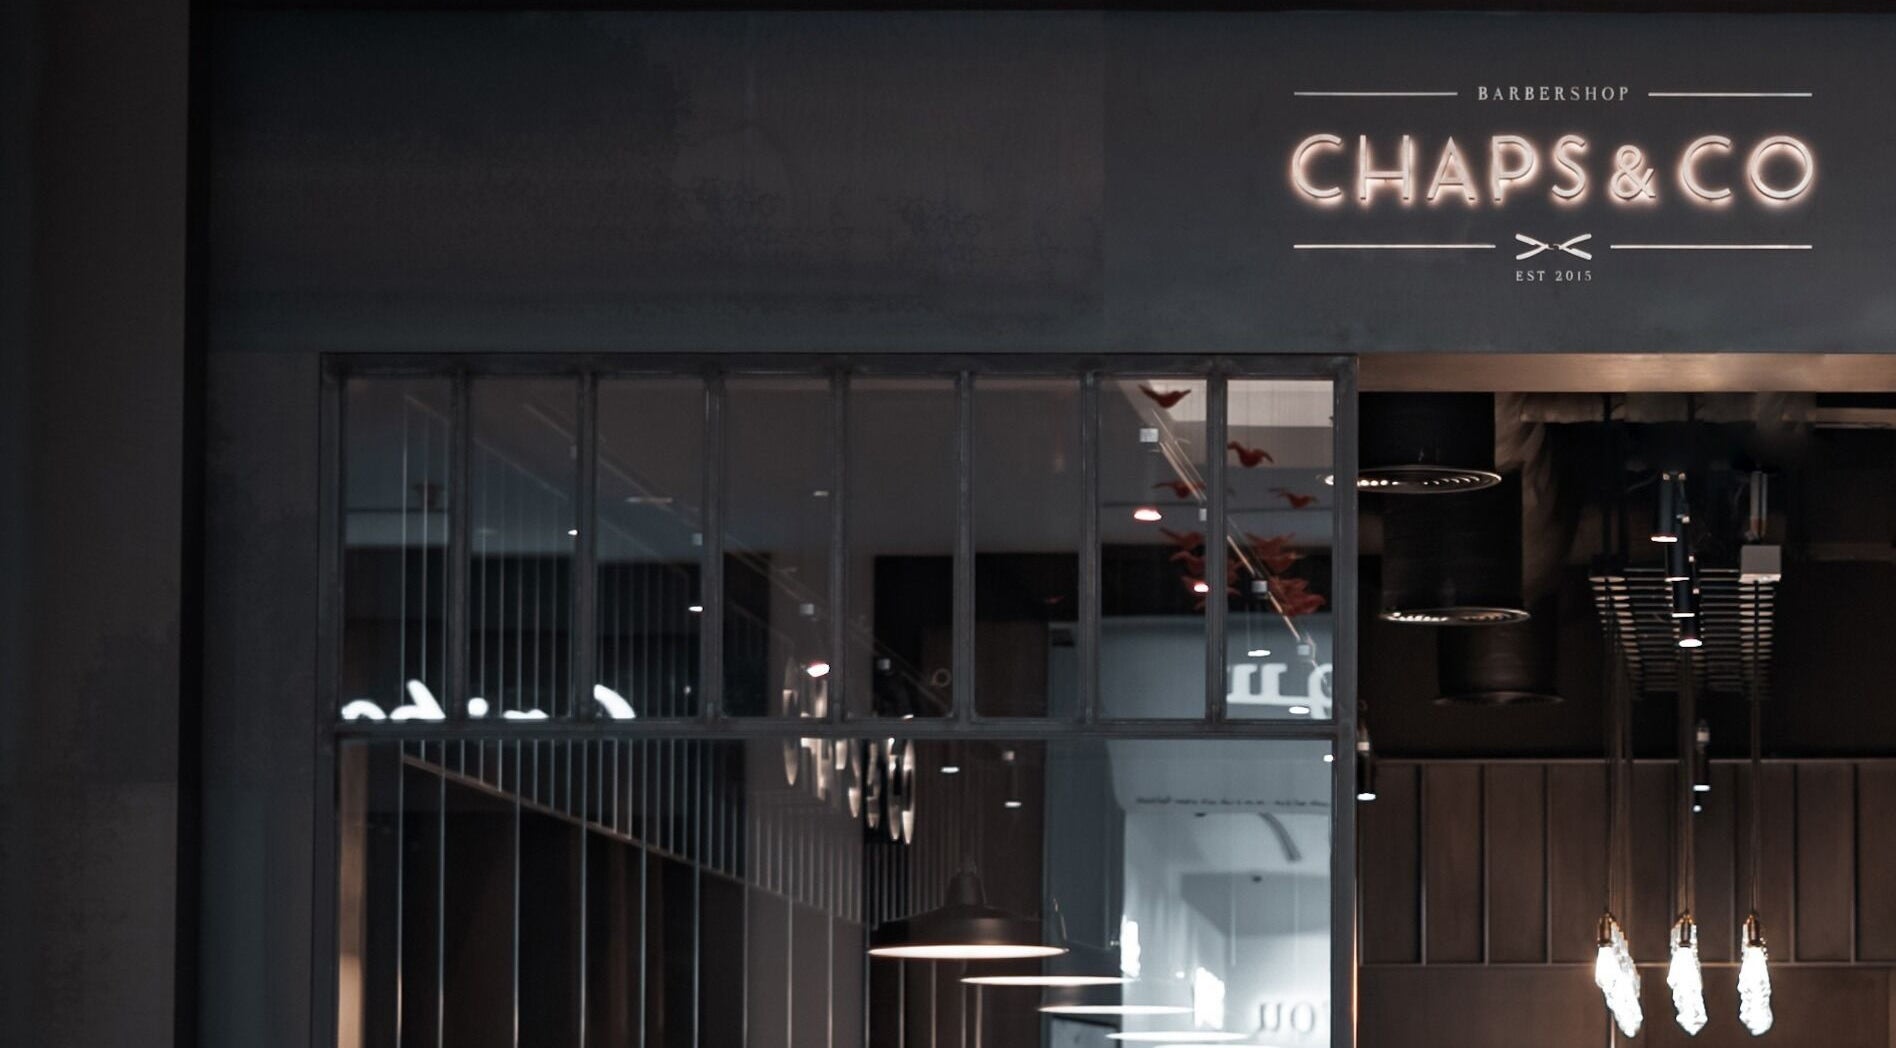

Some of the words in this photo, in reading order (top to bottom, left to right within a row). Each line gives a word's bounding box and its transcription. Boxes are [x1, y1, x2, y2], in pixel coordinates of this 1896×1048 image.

[1478, 86, 1629, 101] BARBERSHOP
[1515, 270, 1545, 282] EST
[1555, 270, 1593, 282] 2015
